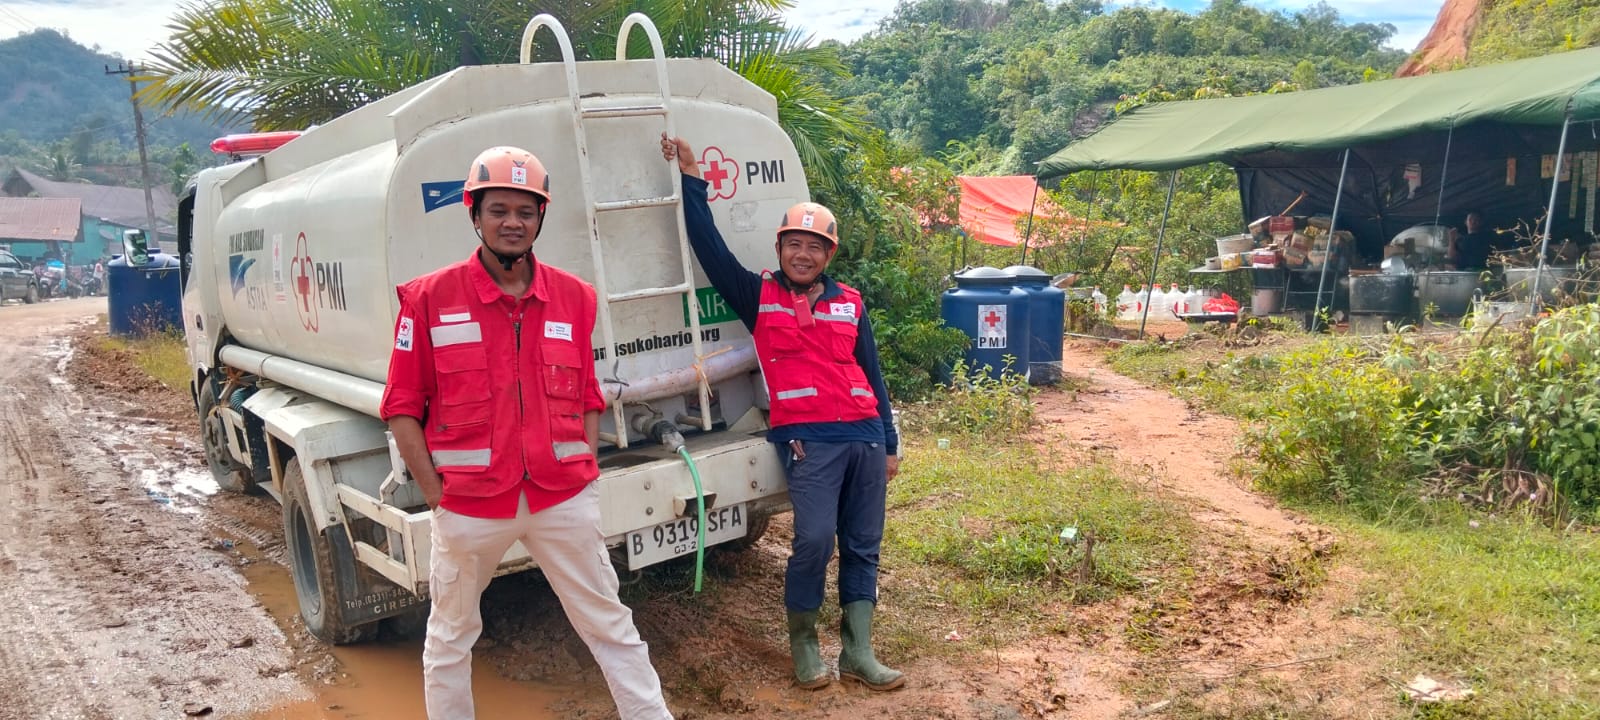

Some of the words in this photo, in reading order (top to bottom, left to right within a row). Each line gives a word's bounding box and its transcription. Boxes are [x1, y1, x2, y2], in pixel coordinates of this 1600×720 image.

[746, 160, 785, 185] PMI
[316, 262, 347, 311] PMI
[979, 337, 1006, 347] PMI
[633, 533, 644, 556] B
[653, 517, 699, 548] 9319
[708, 506, 742, 532] SFA
